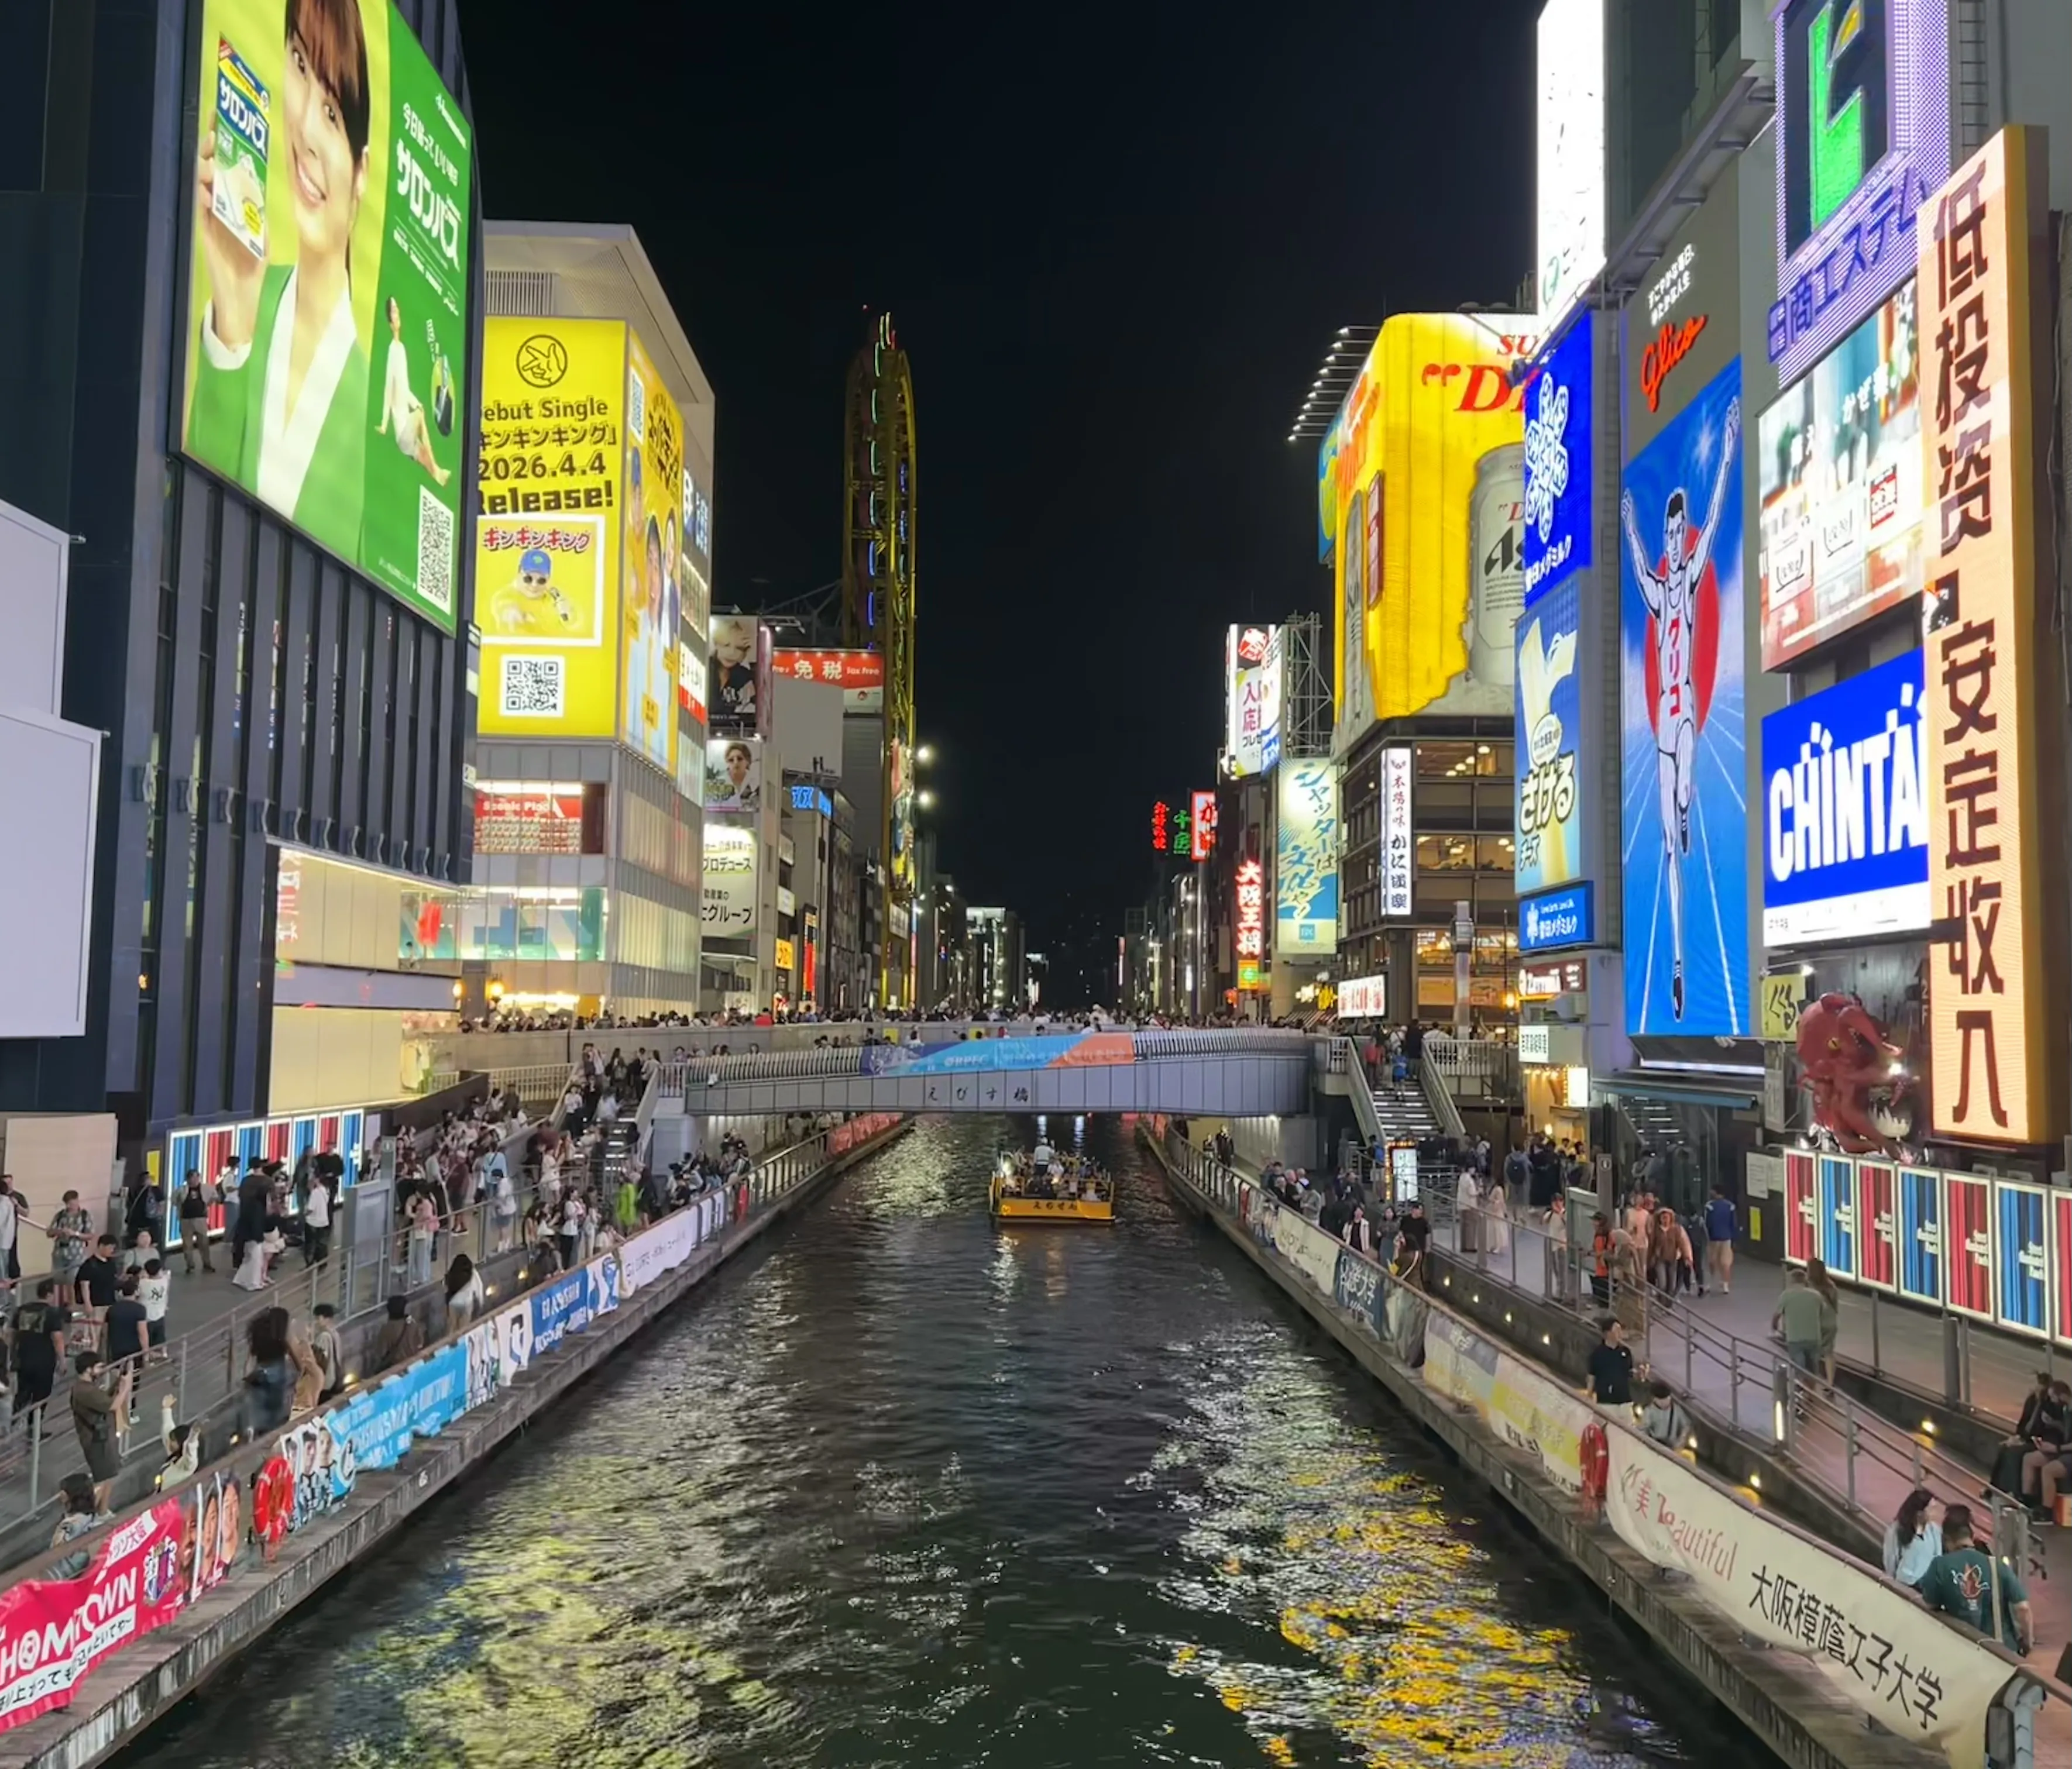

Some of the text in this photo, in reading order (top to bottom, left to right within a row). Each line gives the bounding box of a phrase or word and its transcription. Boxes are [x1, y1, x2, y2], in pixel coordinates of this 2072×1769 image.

[396, 137, 461, 273] サロンパス
[1768, 165, 1932, 365] 日商エステム
[480, 397, 609, 425] ebut Single
[479, 452, 606, 480] 2026.4.4
[793, 659, 844, 680] 免税
[1668, 608, 1681, 718] グリコ
[1521, 749, 1575, 835] さける
[1235, 859, 1262, 956] 大阪王将
[1390, 834, 1407, 908] かに道楽
[927, 1086, 1031, 1103] えびす橋
[1657, 1492, 1738, 1582] Beautiful
[0, 1567, 138, 1686] HOMTOWN
[1748, 1564, 1943, 1730] 大阪樟蔭女子大学
